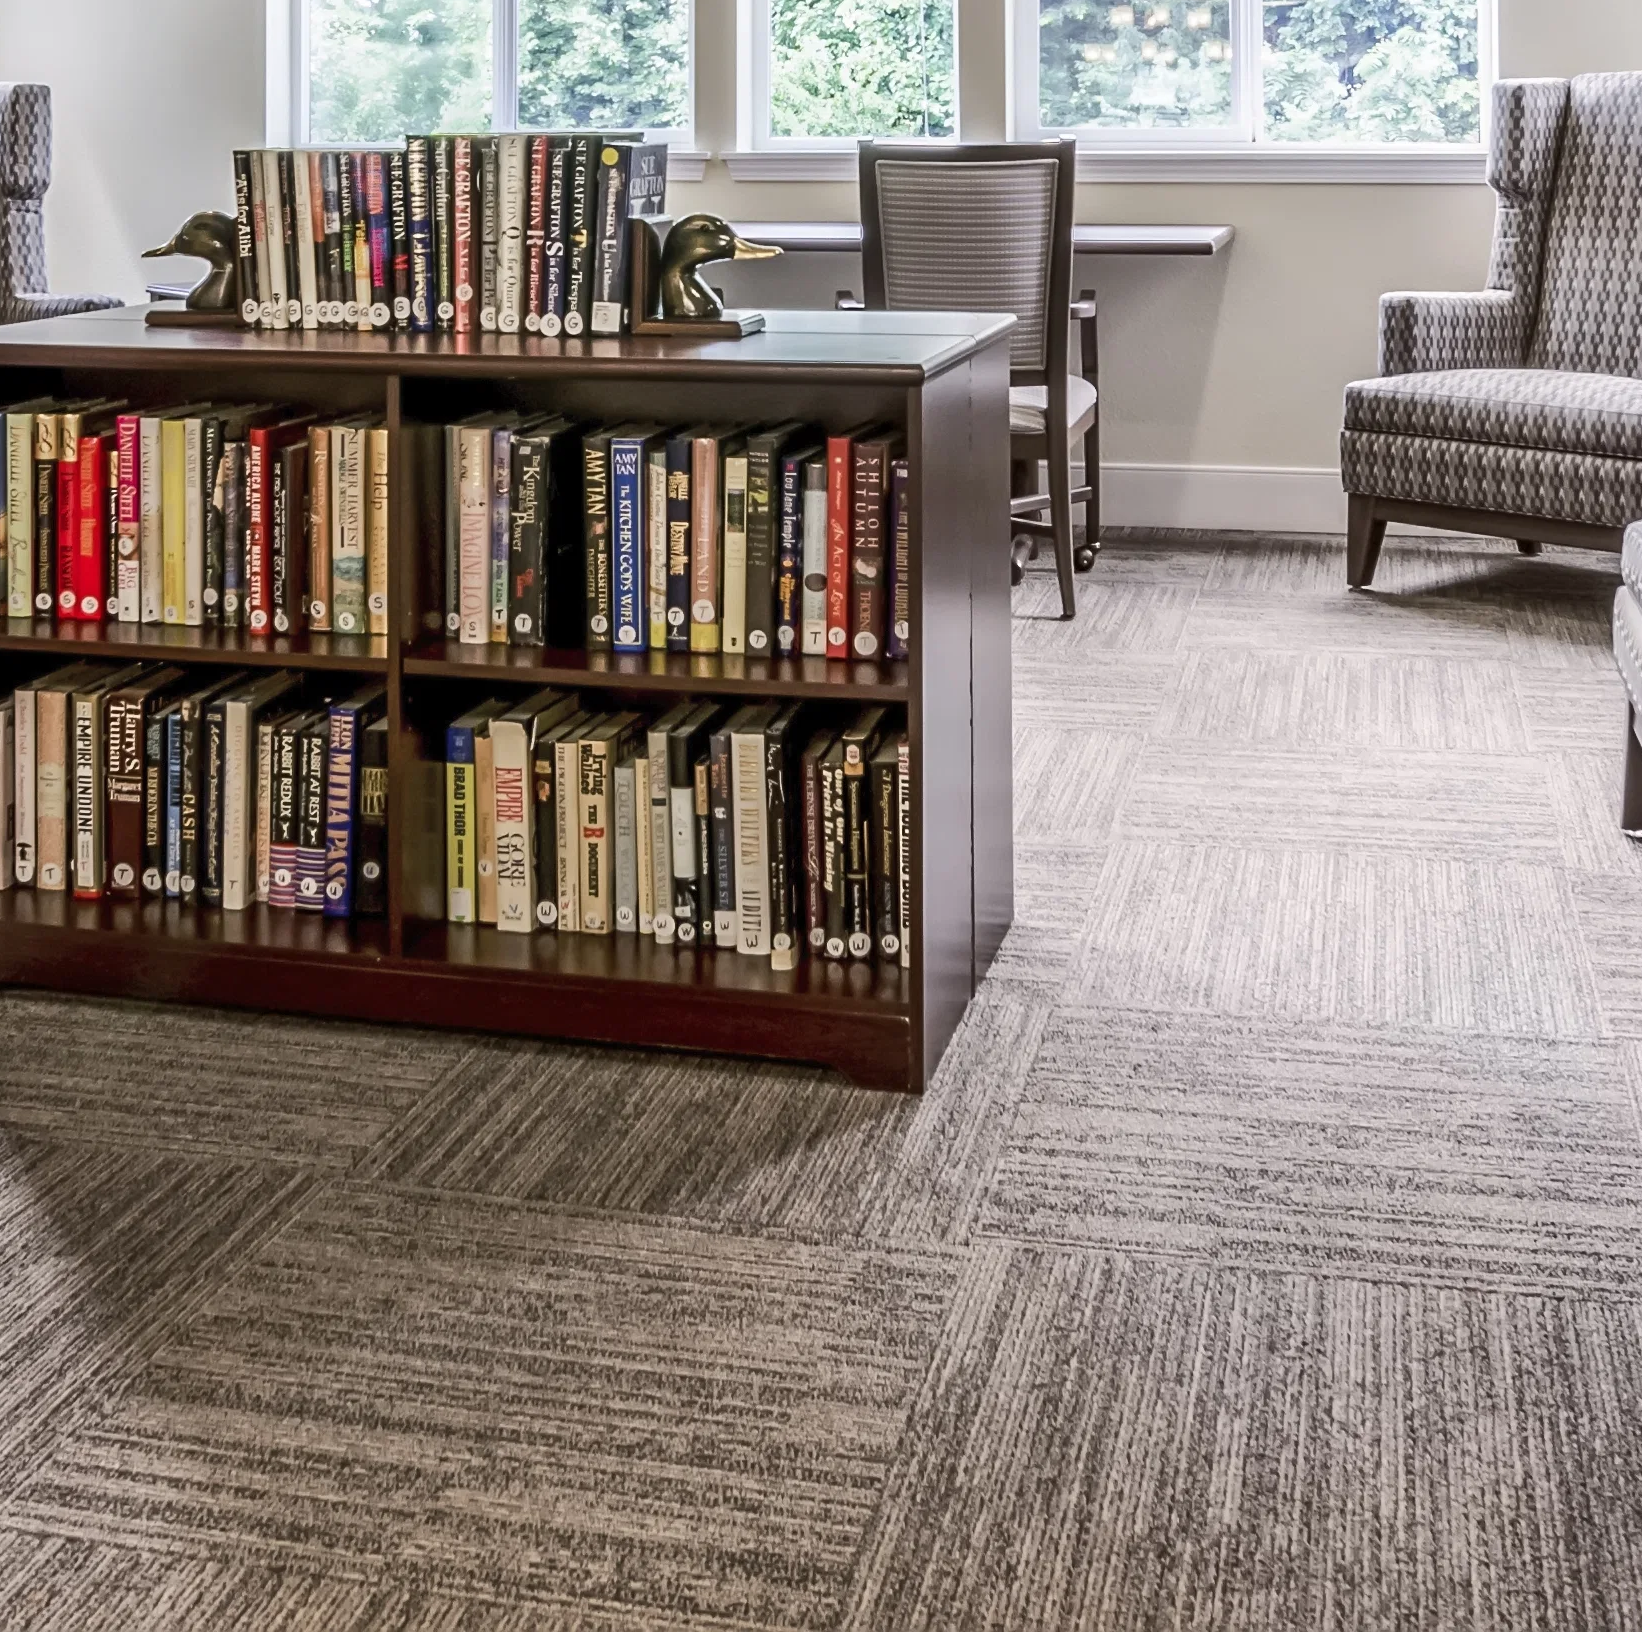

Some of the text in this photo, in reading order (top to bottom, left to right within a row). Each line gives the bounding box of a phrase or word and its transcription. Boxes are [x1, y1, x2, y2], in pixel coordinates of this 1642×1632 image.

[390, 155, 405, 239] SUE GRAFTON
[455, 138, 470, 241] SUE GRAFTON
[527, 166, 543, 245] GRAFTON R
[571, 140, 587, 269] SUE GRAFTON T for
[239, 226, 251, 257] Alibi
[502, 227, 521, 239] Q
[546, 155, 563, 313] SUE GRAFTON S for Silenc
[10, 426, 26, 484] DANIELLE
[206, 428, 214, 452] MARY
[615, 453, 637, 463] AMY
[616, 464, 635, 474] TAN
[119, 423, 136, 522] DANIELLE STEEL
[347, 433, 358, 548] SUMMER HARVEST
[371, 473, 387, 510] Help
[522, 467, 539, 523] Kingdom
[586, 449, 606, 515] AMY TAN
[10, 488, 26, 525] STEEL
[251, 446, 261, 605] AMERICA ALONE MARK STEYN
[781, 472, 797, 549] Lou Jane Temple
[855, 457, 866, 548] AUTUMN
[868, 458, 880, 548] SHILOH
[463, 513, 486, 580] IMAGINE
[512, 513, 526, 552] Power
[619, 500, 632, 623] KITCHEN GOD'S WIFE
[833, 546, 844, 567] ACT
[126, 567, 137, 588] BIG
[587, 549, 595, 598] DAUGHTER
[696, 537, 709, 592] LAND
[810, 631, 821, 644] T
[109, 701, 125, 772] Truman
[124, 701, 142, 773] Harry S.
[341, 716, 353, 750] LEON
[77, 717, 93, 836] EMPIRE UNDONE
[232, 725, 242, 861] DIGGING TO AMERICA
[280, 736, 292, 817] RABBIT REDUX
[309, 738, 322, 823] RABBIT AT REST
[454, 767, 465, 800] BRAD
[495, 767, 523, 823] EMPIRE
[557, 747, 566, 850] THE PROJECT
[580, 744, 594, 795] Wallace
[590, 754, 606, 796] Irving
[711, 764, 719, 789] Walls
[182, 794, 195, 840] CASH
[454, 804, 465, 836] THOR
[738, 743, 762, 866] BARBARA WALTERS
[806, 781, 815, 853] PURPOSE DRIVEN
[822, 770, 835, 892] Priests Is Missing
[833, 799, 844, 844] of Our
[880, 784, 892, 876] Dangerous Inheritance
[496, 832, 510, 885] VIDAL
[510, 833, 526, 888] GORE
[582, 805, 605, 898] THE R DOCUMENT
[718, 845, 727, 888] SILVER
